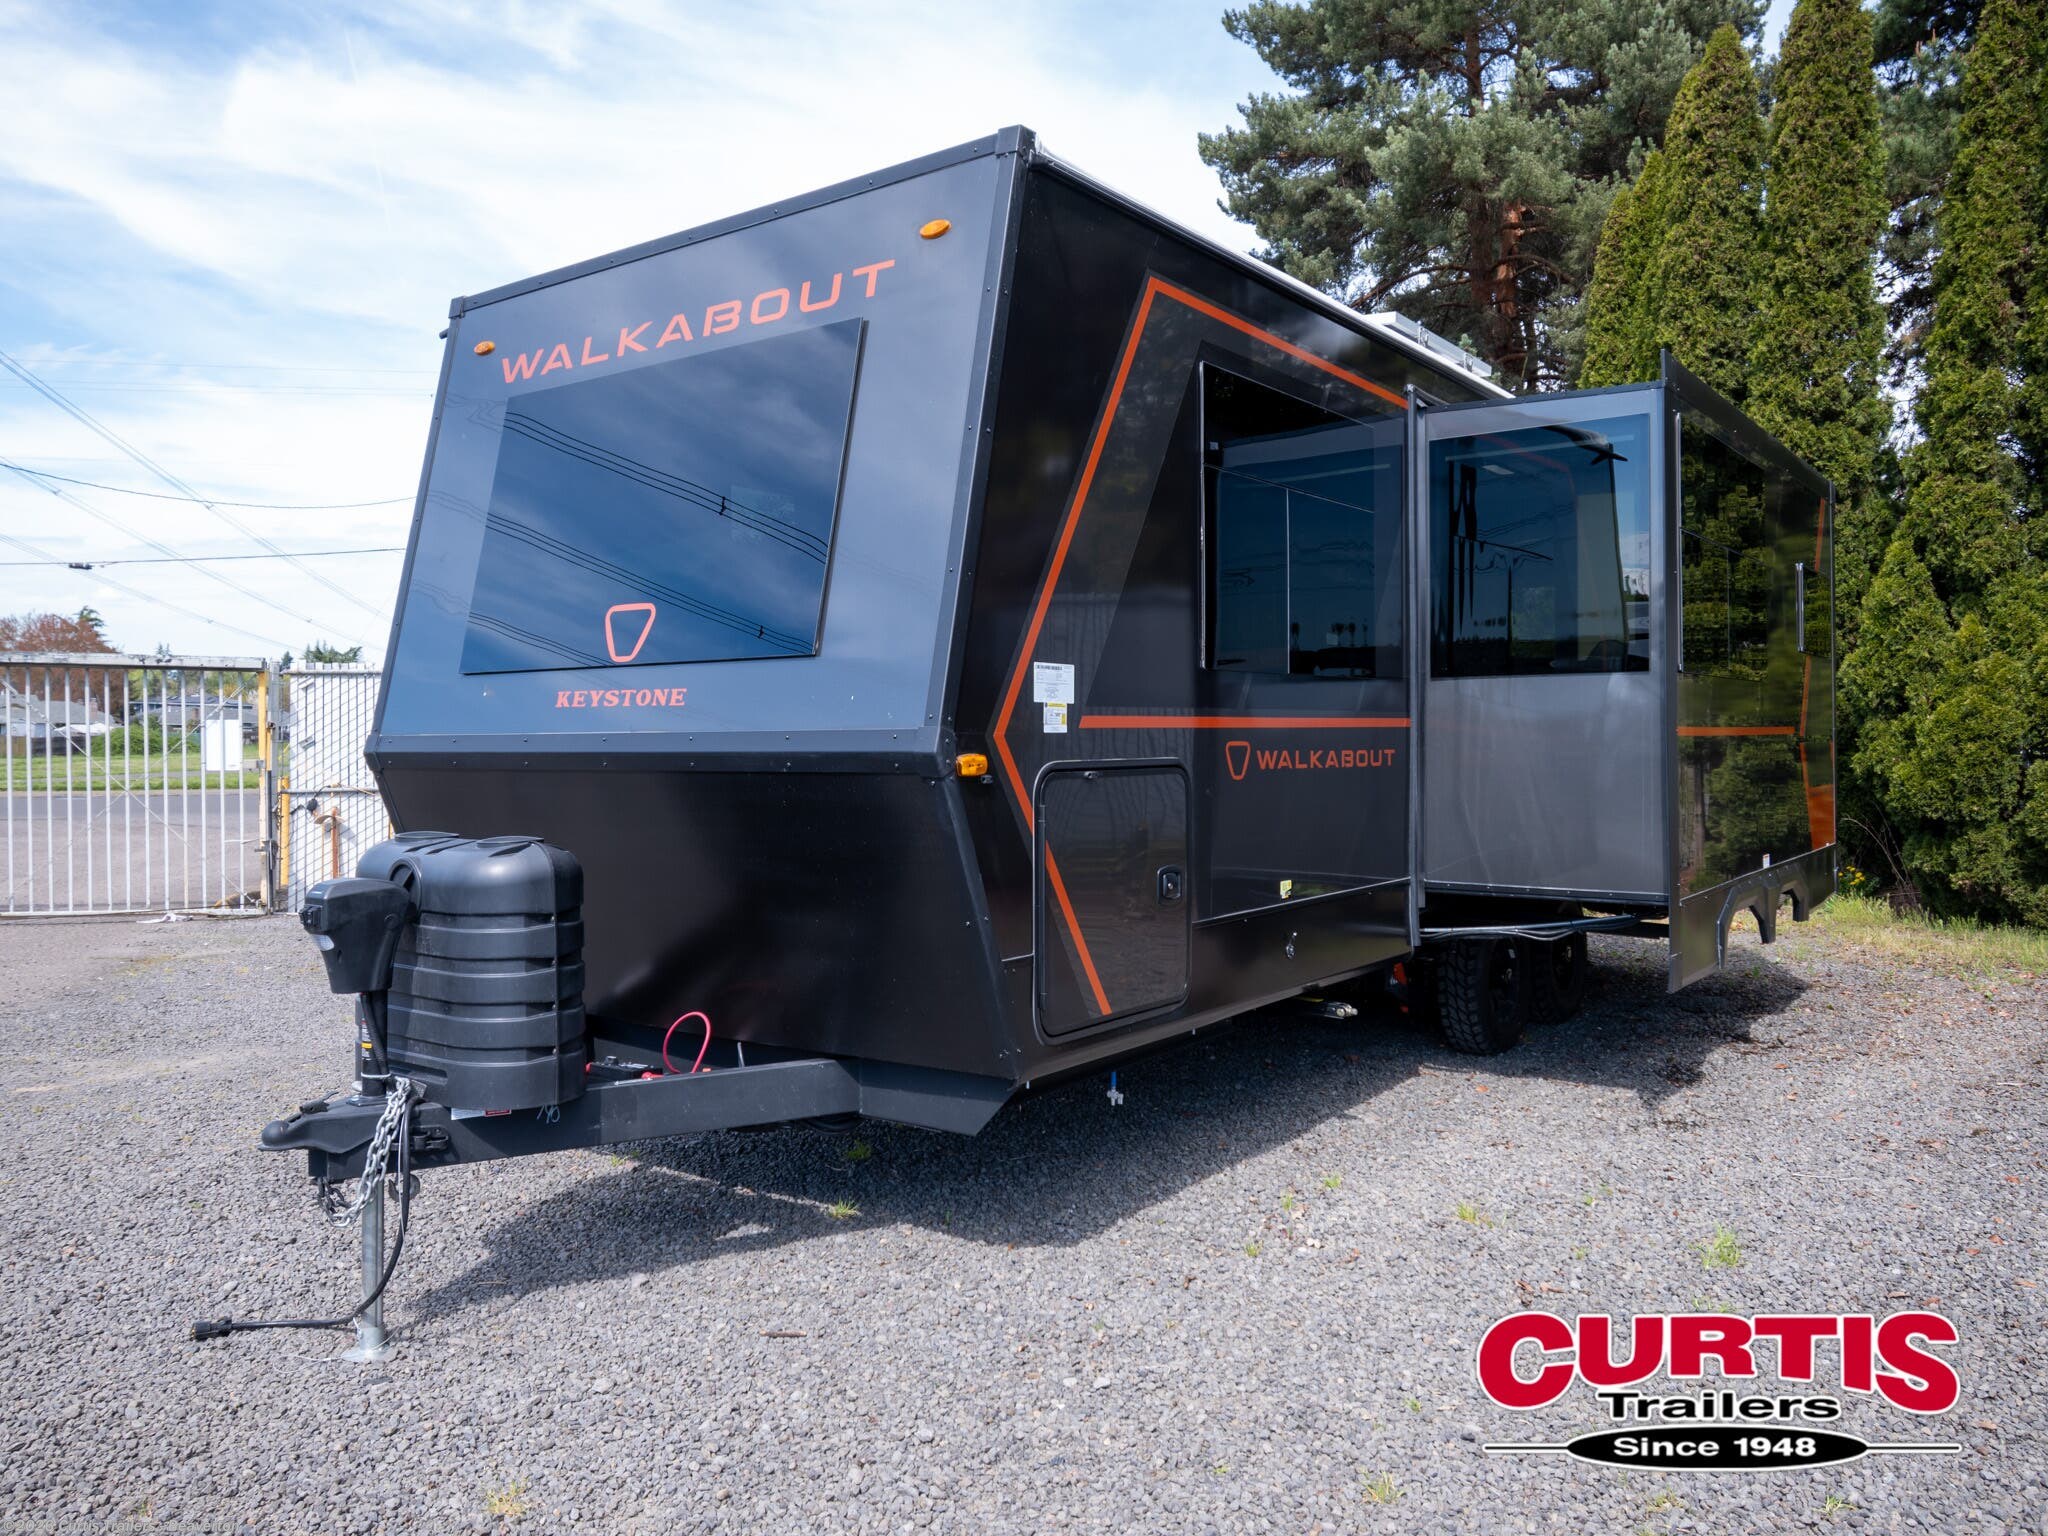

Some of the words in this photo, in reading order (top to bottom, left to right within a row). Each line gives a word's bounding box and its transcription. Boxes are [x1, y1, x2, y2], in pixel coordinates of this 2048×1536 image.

[501, 259, 896, 383] WALKABOUT
[554, 688, 688, 708] KEYSTONE
[1256, 749, 1396, 770] WALKABOUT
